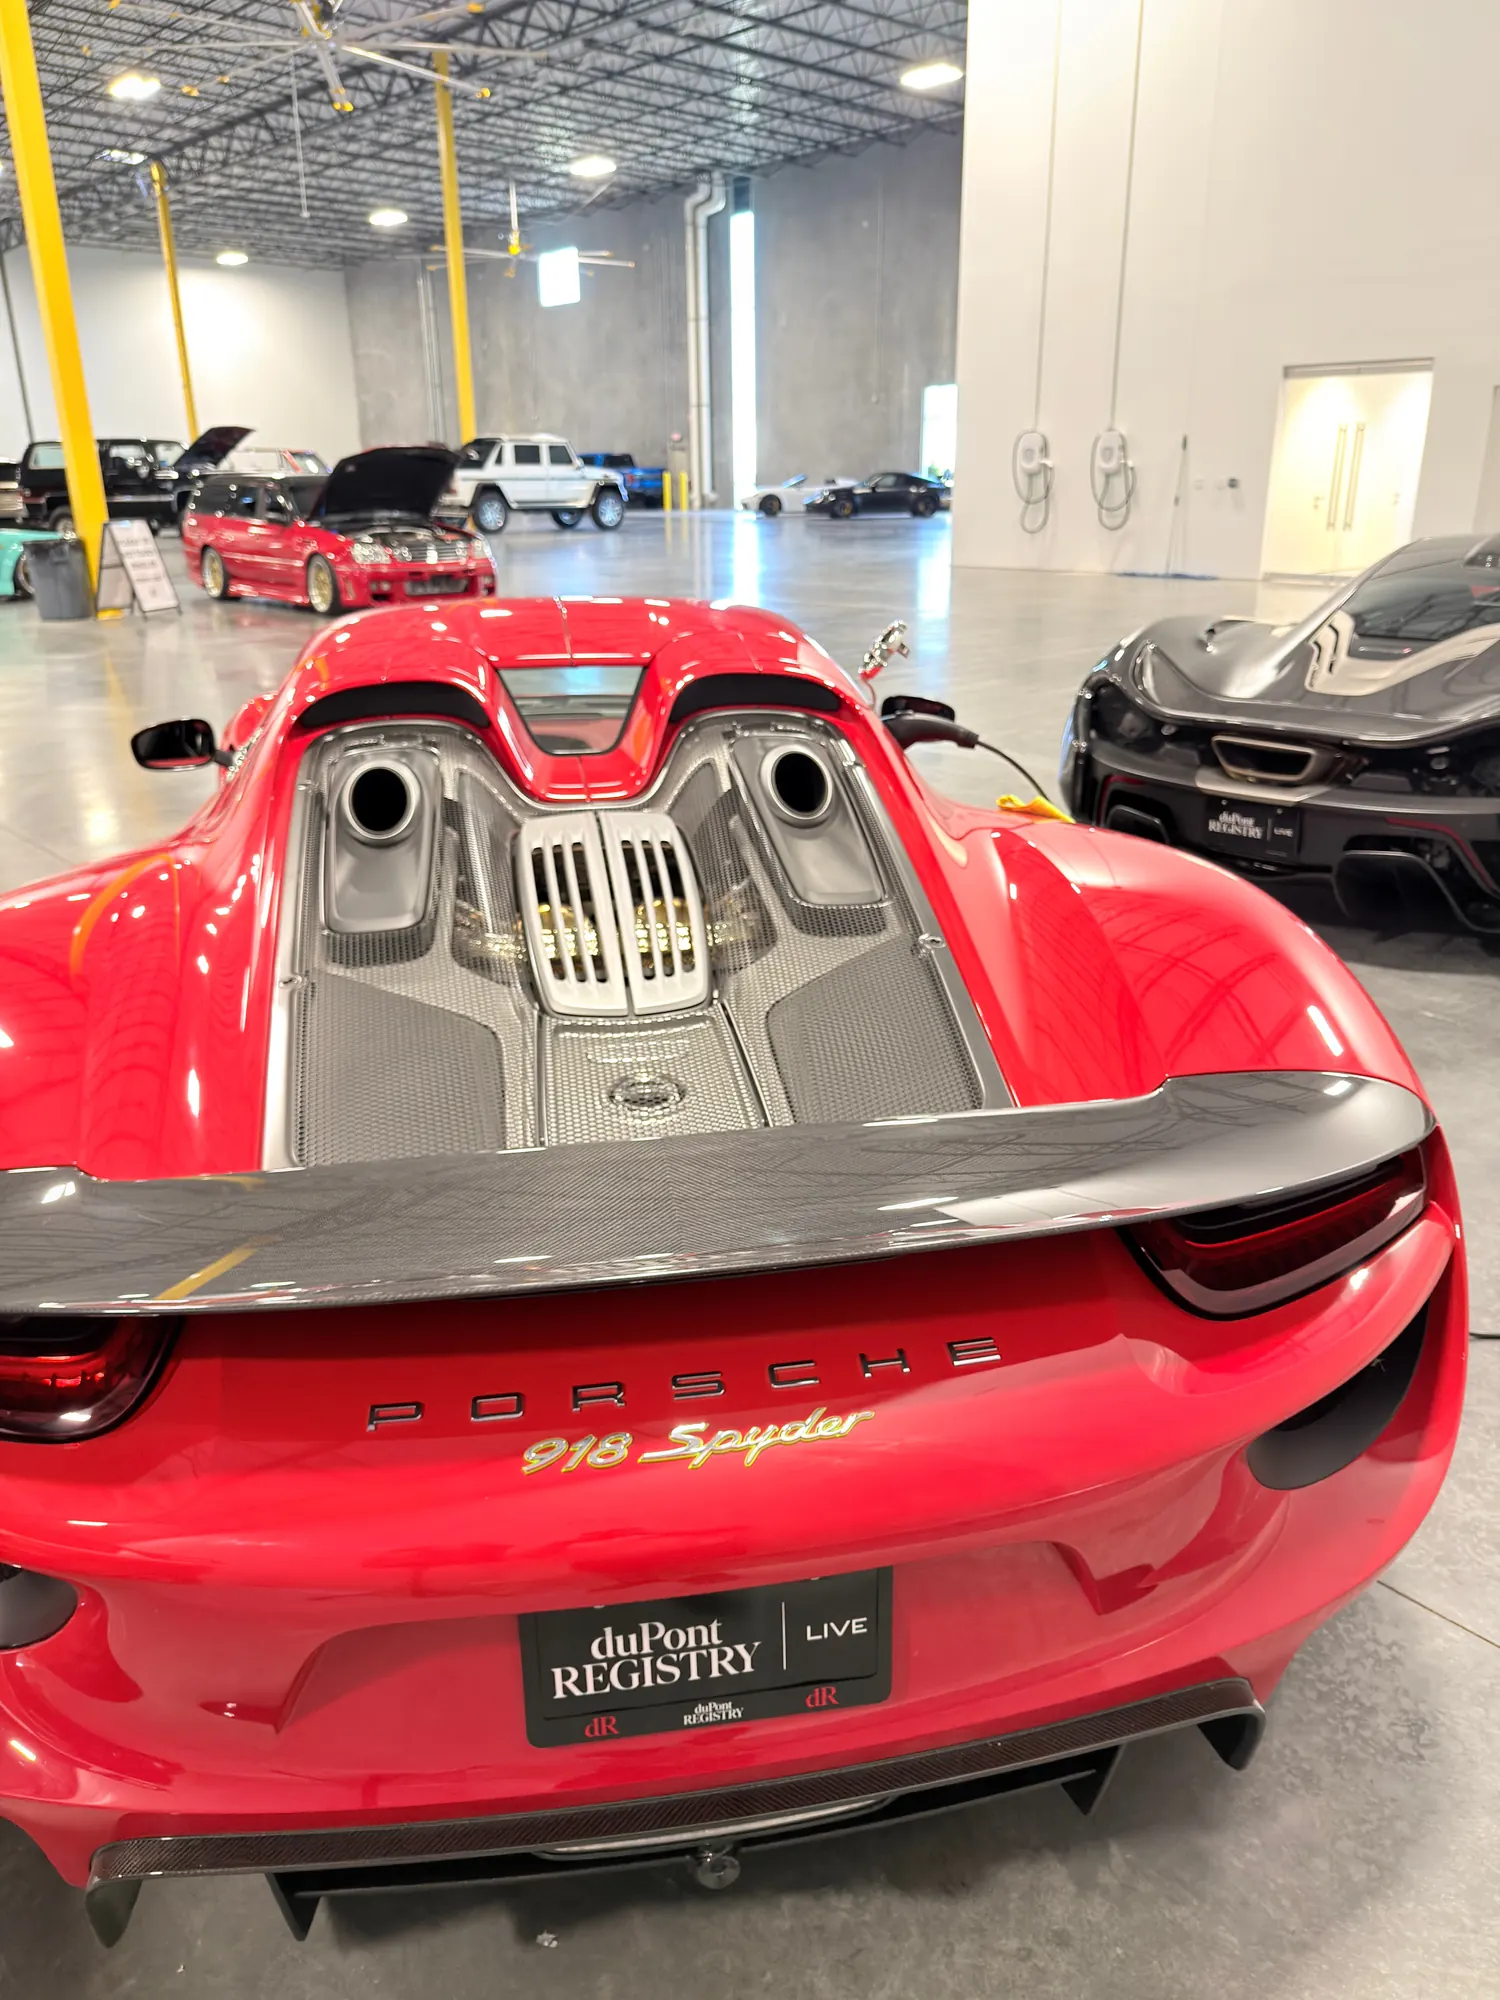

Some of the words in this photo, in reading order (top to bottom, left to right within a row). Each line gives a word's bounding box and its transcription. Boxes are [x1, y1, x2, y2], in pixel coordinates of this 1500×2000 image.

[1208, 819, 1263, 839] REGISTRY
[366, 1336, 1004, 1432] PORSCHE
[521, 1432, 634, 1475] 918
[638, 1406, 875, 1469] Spyder
[590, 1618, 723, 1660] duPont
[806, 1617, 868, 1641] LIVE
[551, 1642, 762, 1699] REGISTRY
[694, 1701, 732, 1714] duPont
[805, 1686, 839, 1708] dR
[584, 1716, 620, 1738] dR
[683, 1707, 744, 1725] REGISTRY
